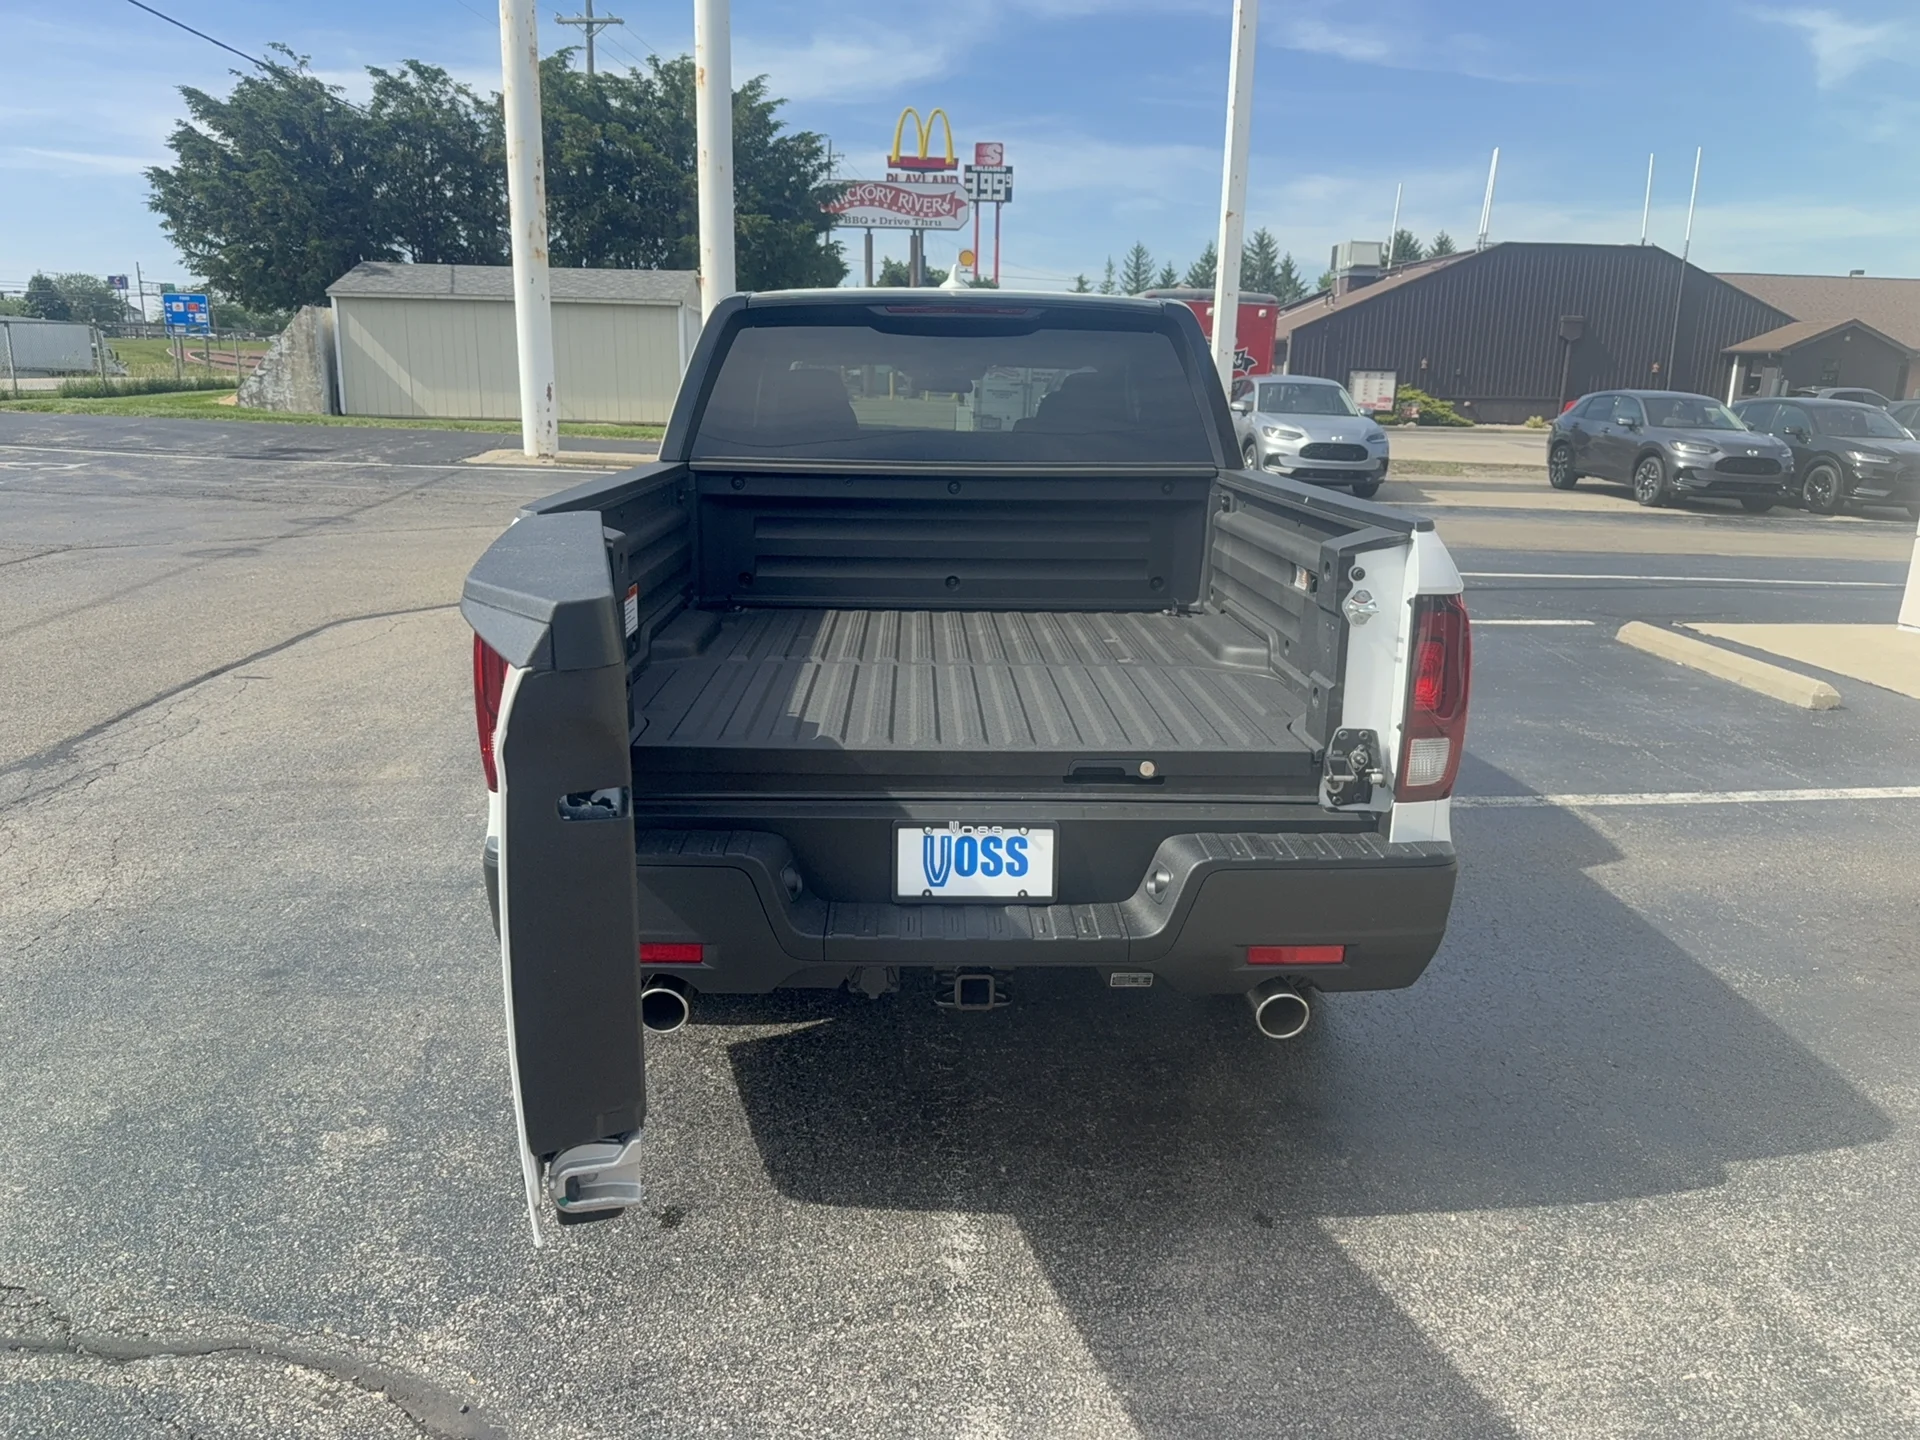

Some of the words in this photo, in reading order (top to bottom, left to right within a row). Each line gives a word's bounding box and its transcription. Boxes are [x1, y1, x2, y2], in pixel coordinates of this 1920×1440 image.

[844, 216, 868, 225] BBQ
[879, 217, 910, 226] Drive
[913, 218, 942, 227] Thru
[923, 835, 1029, 888] VOSS
